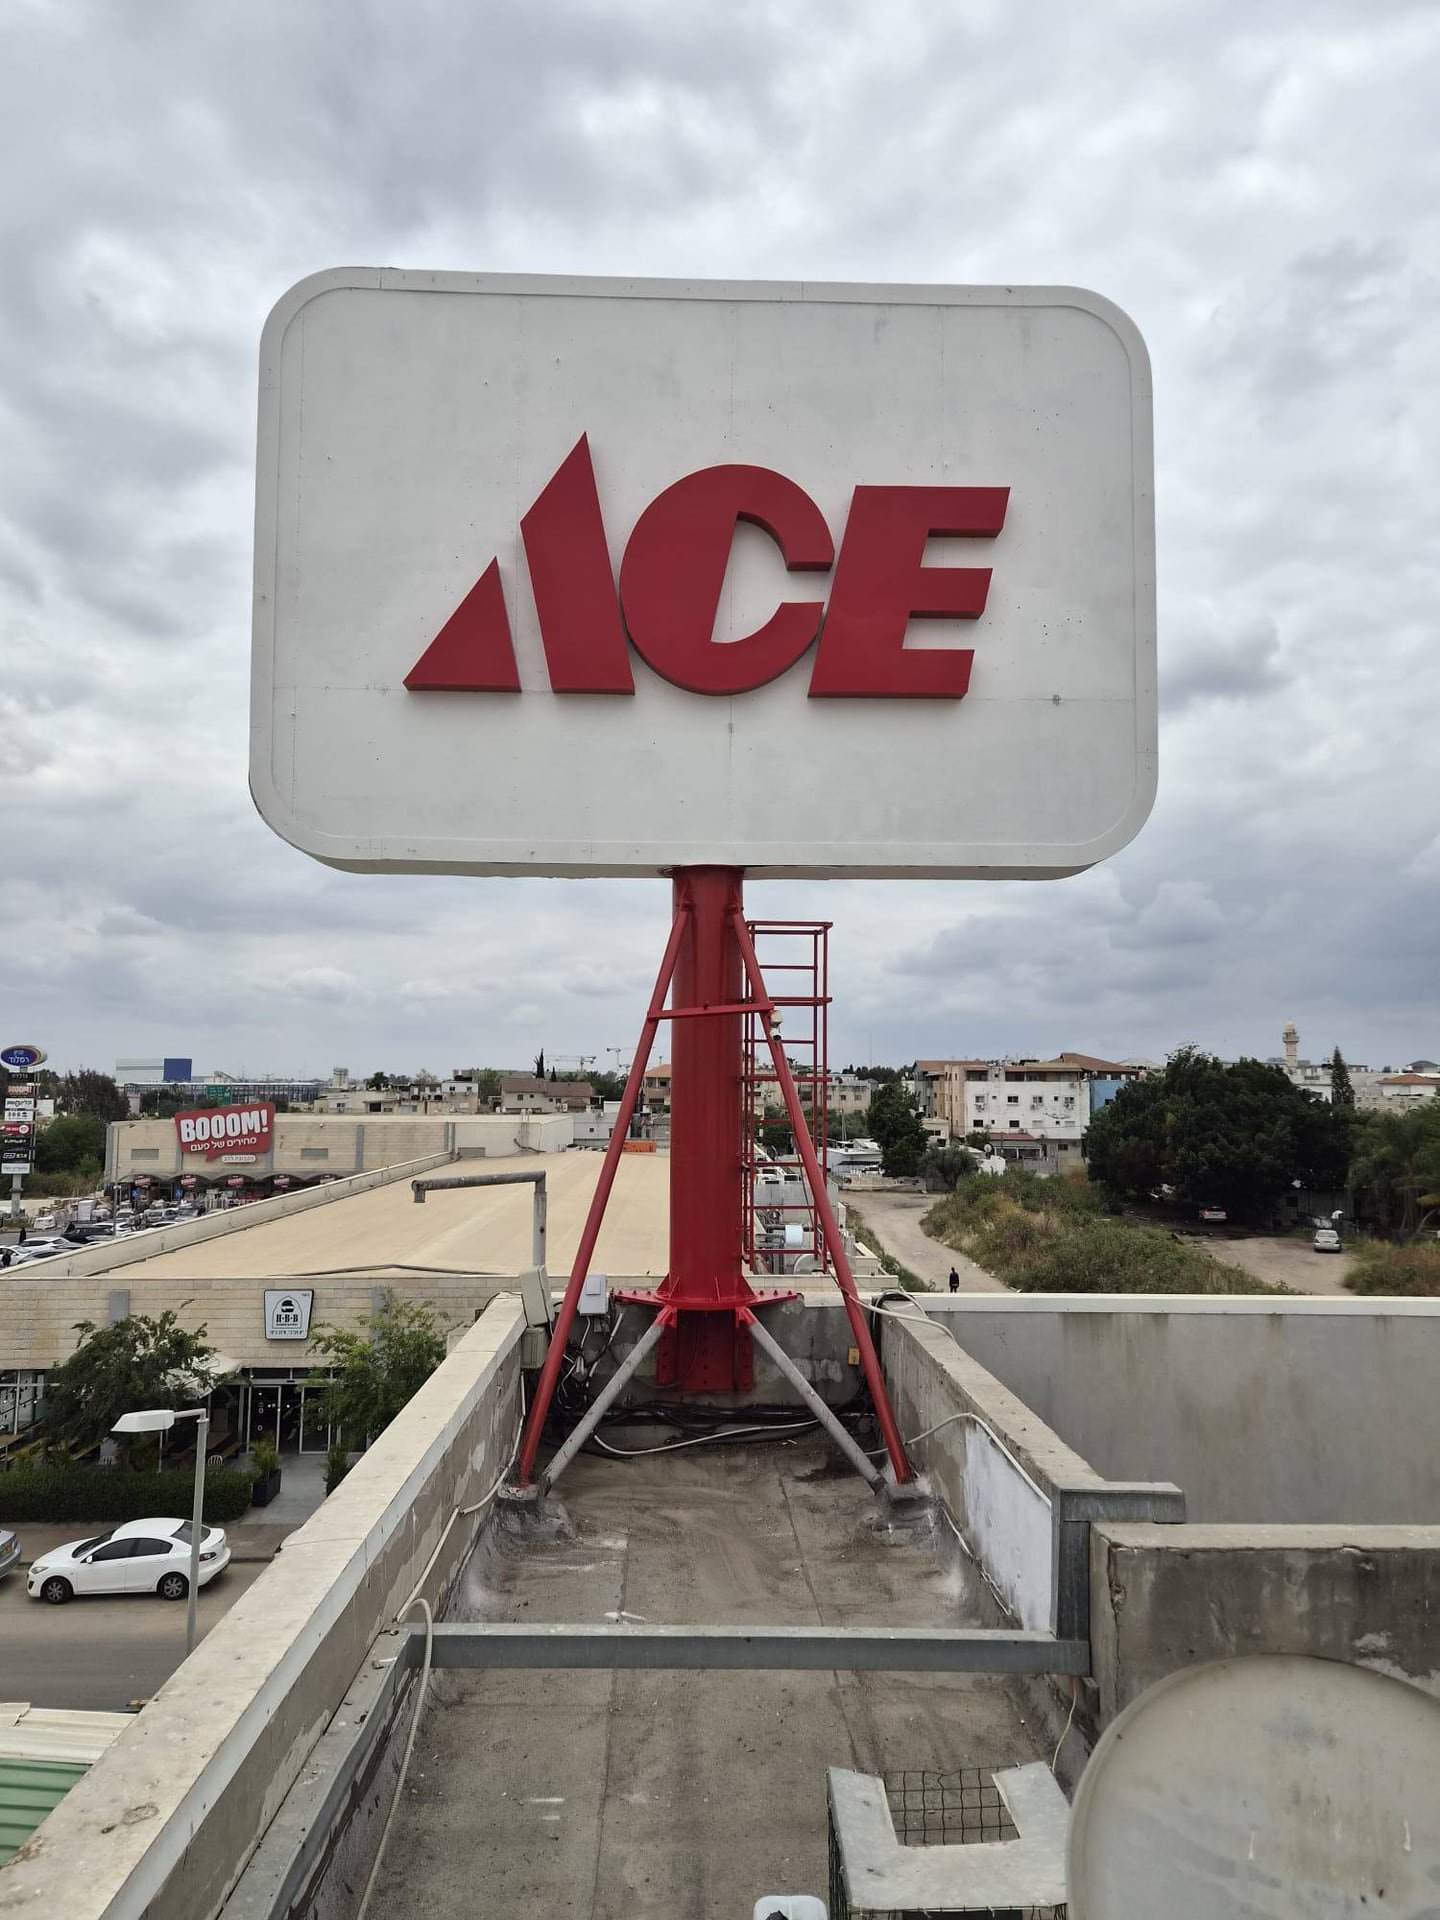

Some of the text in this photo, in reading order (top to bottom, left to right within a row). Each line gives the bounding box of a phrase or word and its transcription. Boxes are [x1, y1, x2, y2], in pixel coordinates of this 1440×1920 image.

[402, 431, 1011, 699] ACE
[180, 1109, 268, 1143] BOOOM!
[190, 1137, 257, 1152] מחירים של פעם
